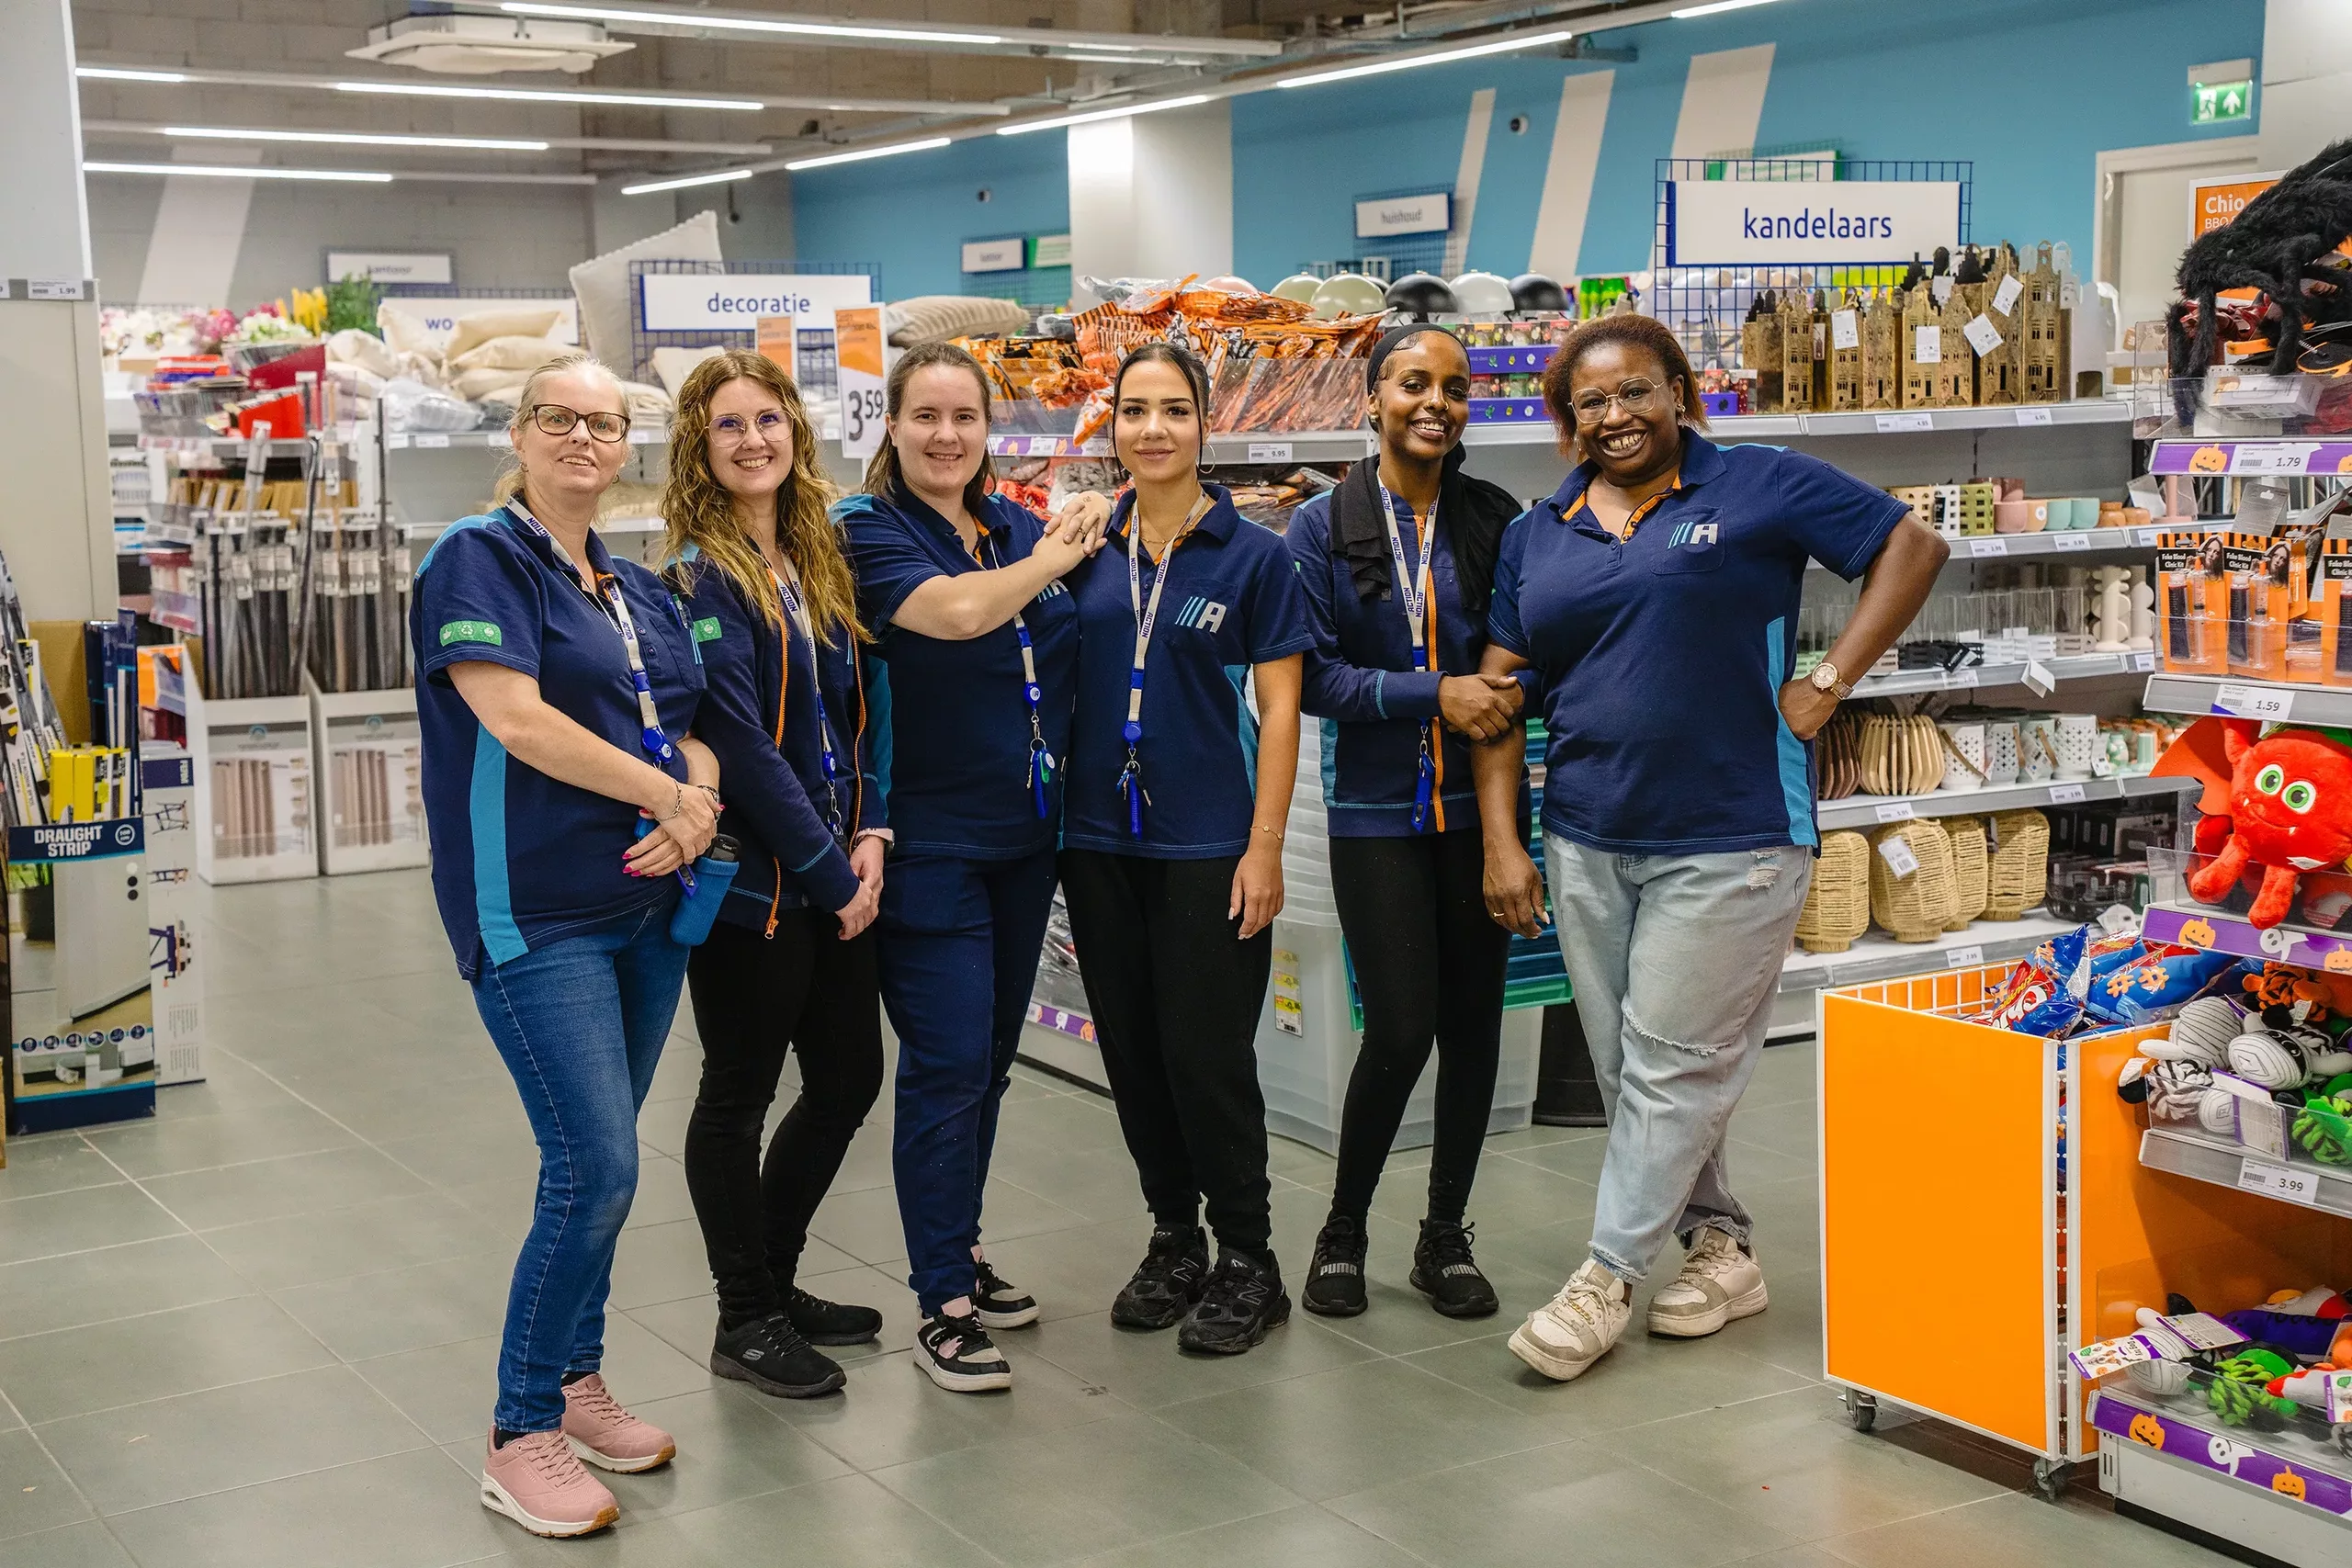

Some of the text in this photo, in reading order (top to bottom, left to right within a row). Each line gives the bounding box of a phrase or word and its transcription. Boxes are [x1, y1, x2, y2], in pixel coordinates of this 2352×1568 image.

[2205, 194, 2245, 214] Chio
[1744, 208, 1892, 241] kandelaars
[707, 293, 810, 313] decoratie
[2276, 457, 2301, 467] 1.79
[1381, 487, 1391, 511] ACTION
[1392, 537, 1403, 561] ACTION
[1421, 542, 1430, 565] ACTION
[2227, 552, 2251, 562] Fake Blood
[1157, 558, 1168, 583] ACTION
[780, 586, 797, 613] ACTION
[1404, 588, 1415, 613] ACTION
[1416, 592, 1424, 617] ACTION
[621, 621, 635, 640] ACTION
[1142, 612, 1154, 637] ACTION
[2256, 700, 2280, 712] 1.59
[34, 825, 103, 844] DRAUGHT
[48, 841, 92, 857] STRIP
[2278, 1178, 2304, 1192] 3.99
[1320, 1262, 1358, 1277] PUMA
[1442, 1264, 1480, 1279] PUMA
